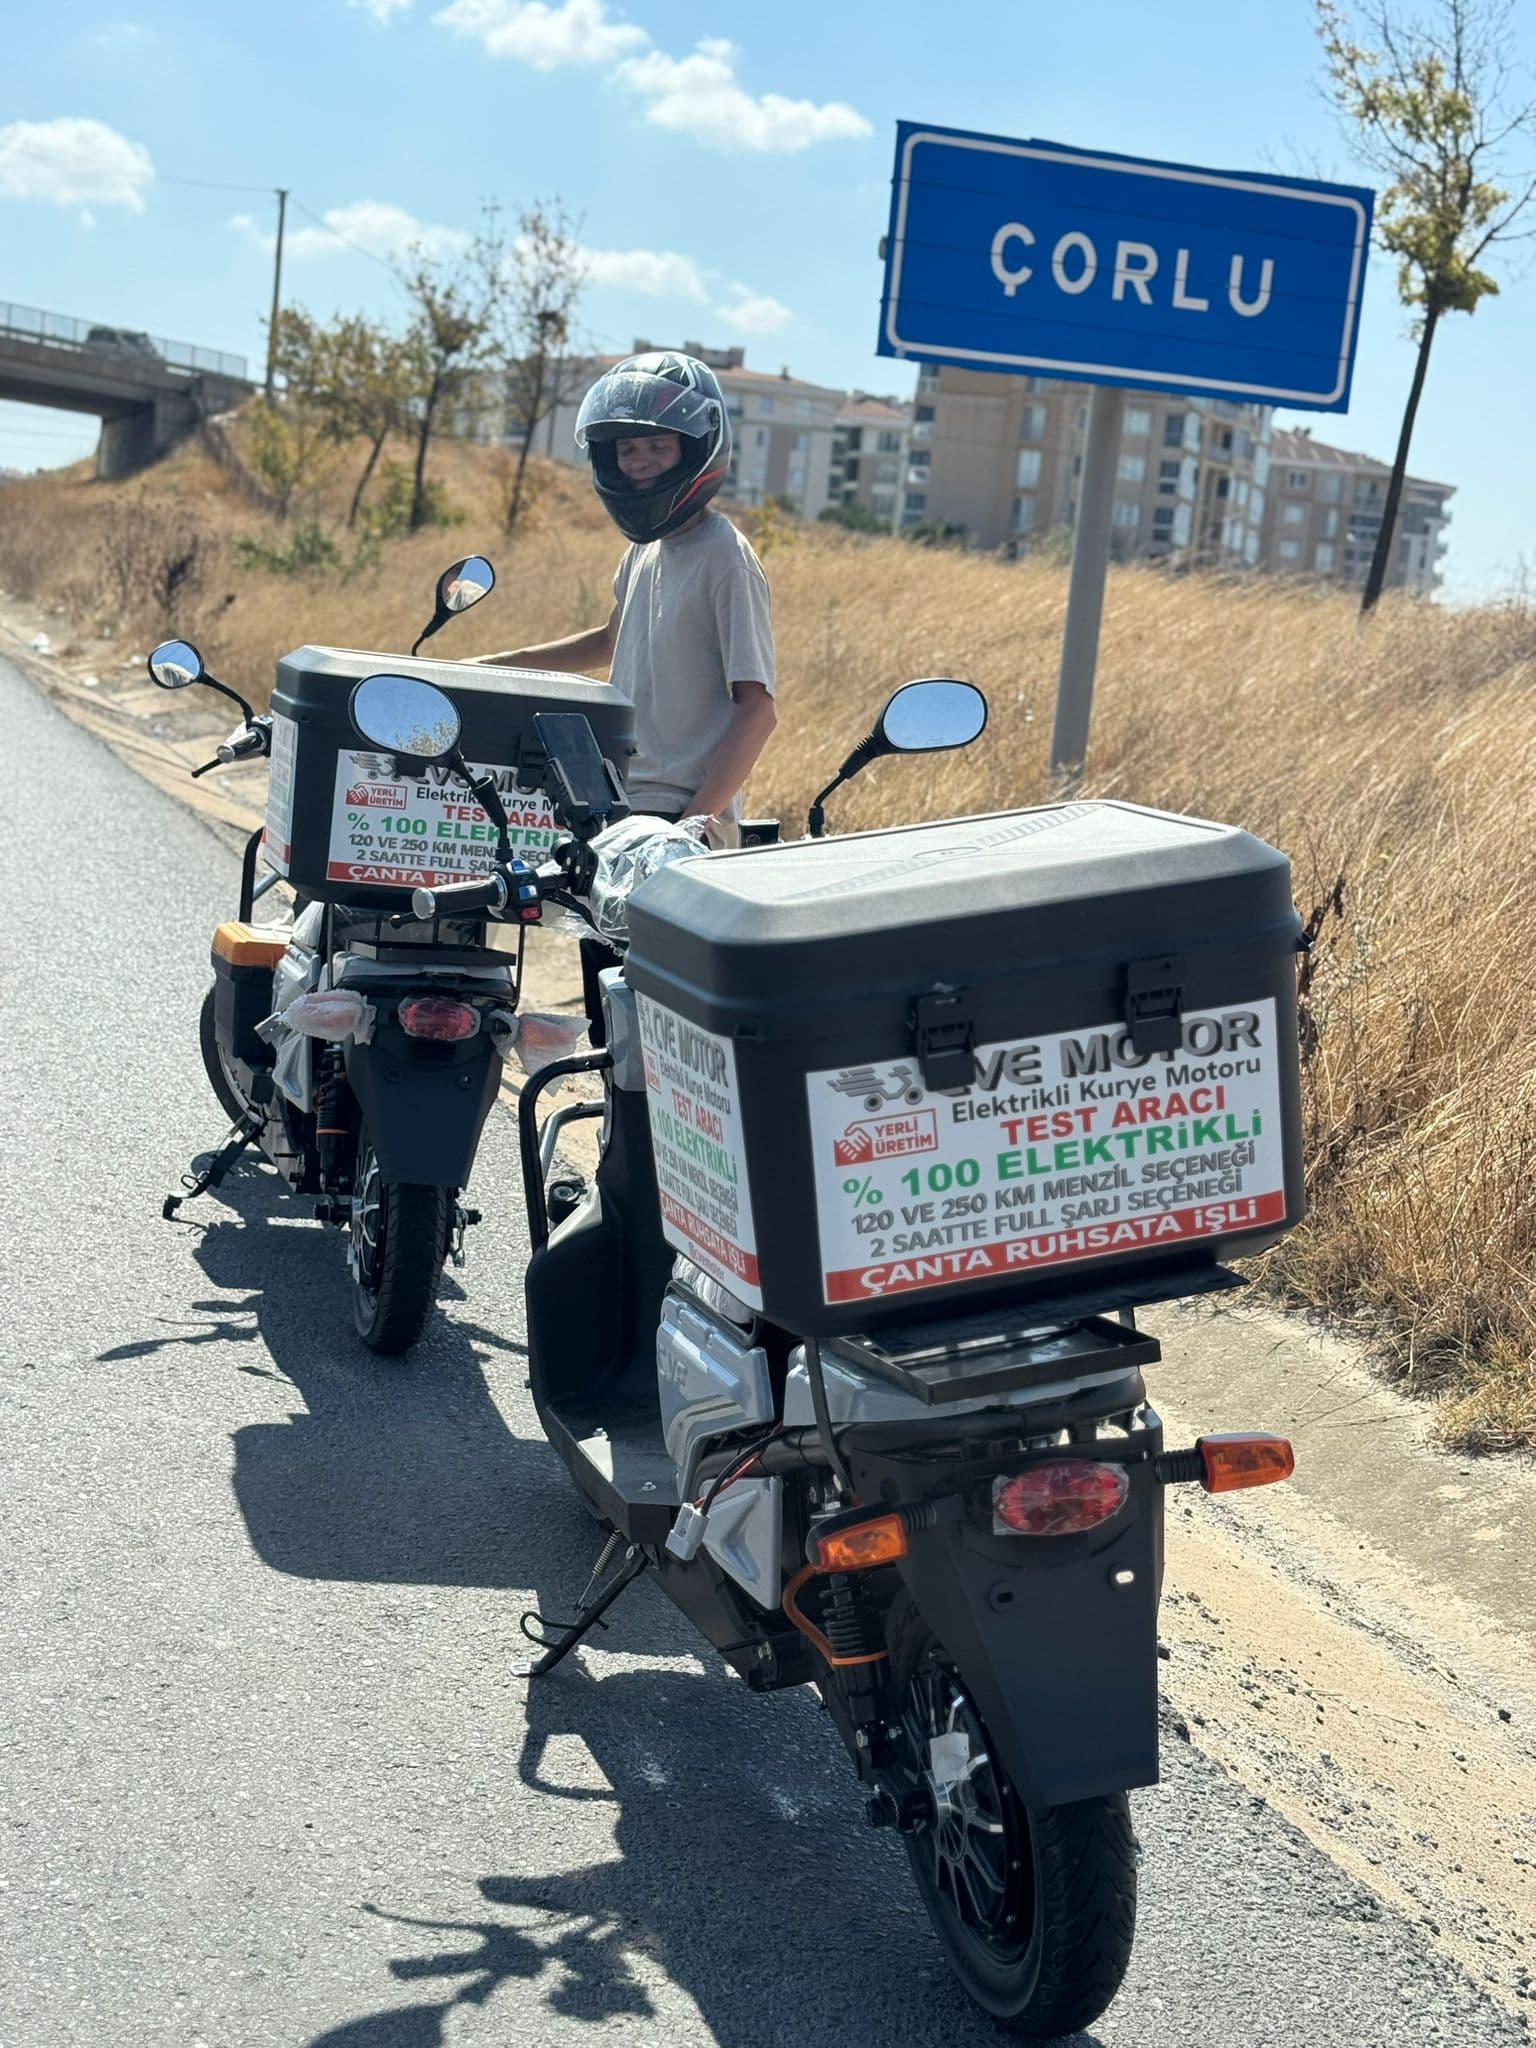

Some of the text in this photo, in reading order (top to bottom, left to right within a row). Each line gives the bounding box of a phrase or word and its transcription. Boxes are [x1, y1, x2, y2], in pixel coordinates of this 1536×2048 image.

[990, 222, 1274, 318] ÇORLU
[371, 787, 397, 796] YERLİ
[416, 786, 480, 804] Elektrik
[502, 798, 537, 811] urye
[443, 804, 485, 822] TES
[347, 812, 370, 831] %
[381, 816, 428, 835] 100
[348, 833, 374, 847] 120
[377, 836, 398, 849] VE
[400, 838, 429, 852] 250
[432, 841, 457, 855] KM
[348, 865, 426, 883] ÇANTA
[356, 849, 366, 860] 2
[369, 850, 426, 866] SAATTE
[429, 856, 465, 869] FULL
[677, 1019, 729, 1089] MOTOR
[938, 1011, 1262, 1097] VE MOOR
[951, 1057, 1261, 1123] Elektrikli Kurye Motoru
[657, 1106, 675, 1142] 100
[671, 1088, 693, 1125] TEST
[695, 1104, 724, 1145] ARACI
[874, 1116, 919, 1138] YERLİ
[1000, 1085, 1226, 1146] TEST ARACI
[874, 1133, 933, 1155] ÜRETİM
[842, 1175, 883, 1208] %
[901, 1158, 980, 1197] 100
[851, 1140, 1256, 1235] 120 VE 250 KM MENZİL SEÇENEĞİ
[870, 1168, 1243, 1258] 2 SAATTE FULL ŞARJ SEÇENEĞİ
[860, 1249, 993, 1296] ÇANTA
[1006, 1215, 1181, 1263] RUHSATA
